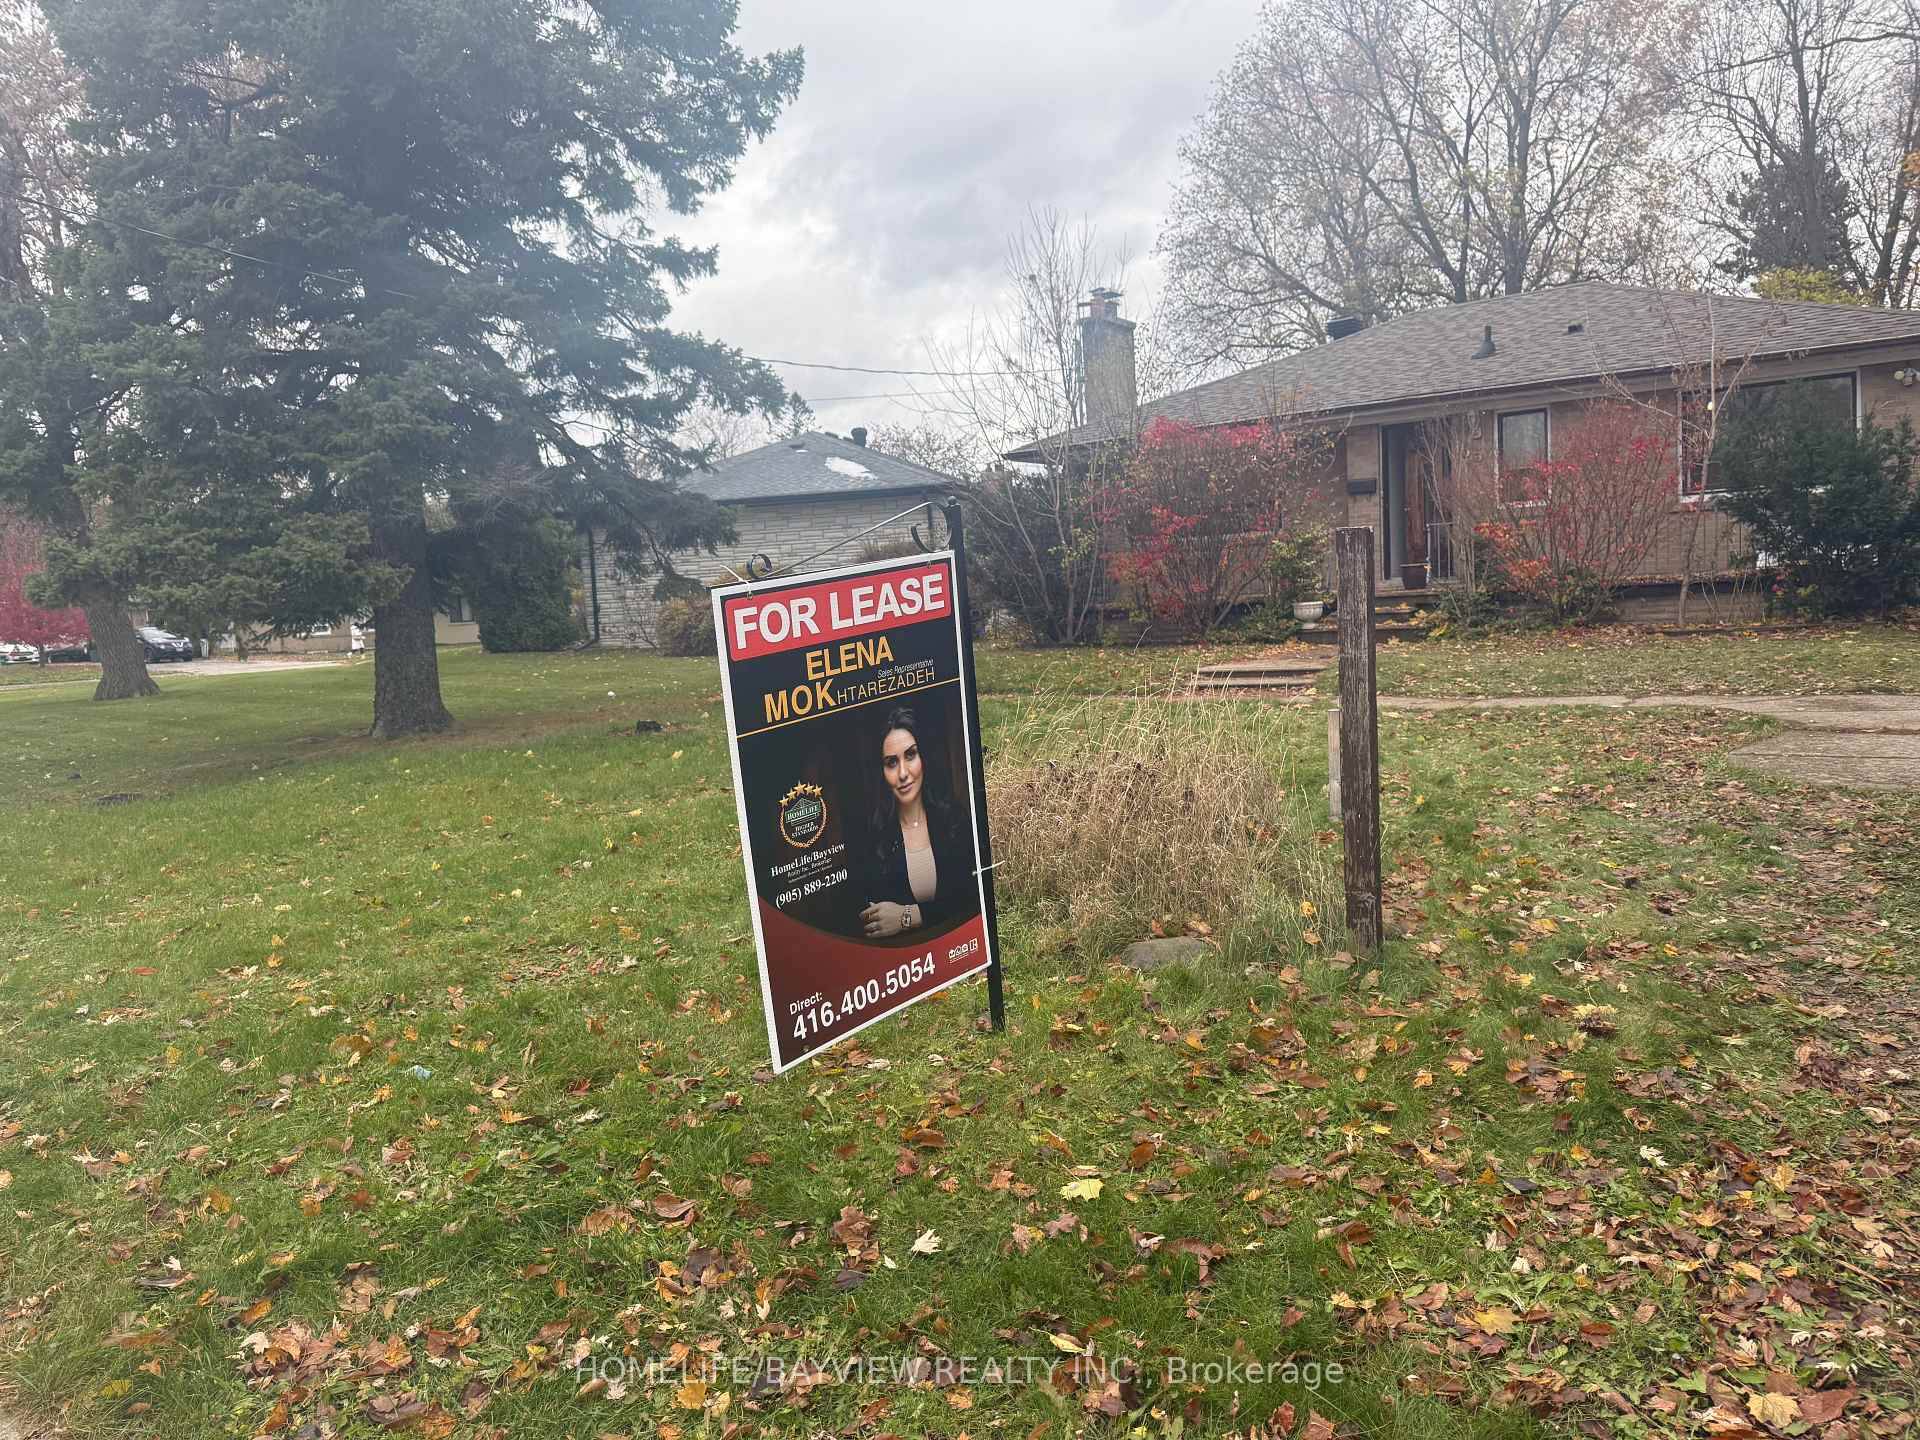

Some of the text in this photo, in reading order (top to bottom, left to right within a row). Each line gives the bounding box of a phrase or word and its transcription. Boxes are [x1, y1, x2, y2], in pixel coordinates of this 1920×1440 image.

[734, 574, 945, 649] FOR LEASE
[806, 635, 895, 681] ELENA
[770, 843, 846, 878] HomeLife/Bayview
[775, 887, 802, 909] (905)
[803, 868, 848, 896] 889-2200
[789, 992, 823, 1015] Direct:
[792, 951, 936, 1040] 416.400.5054
